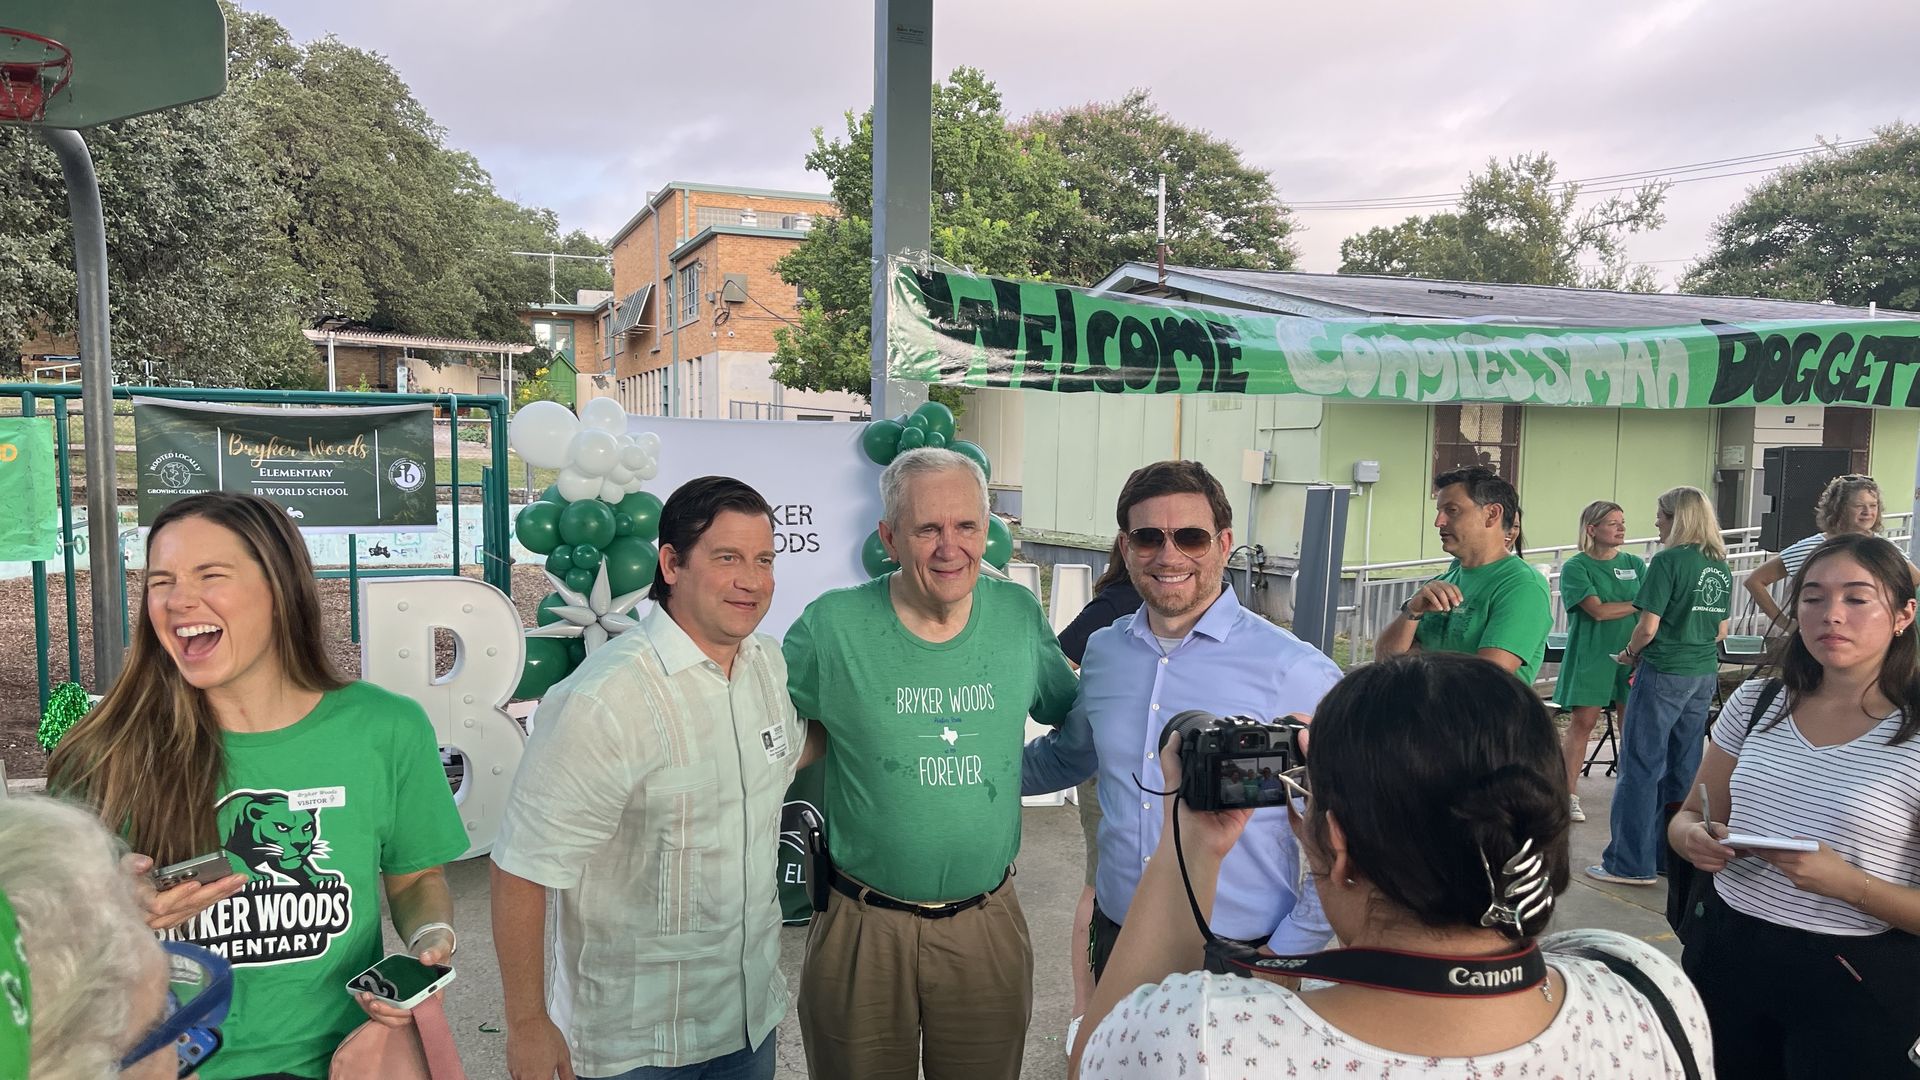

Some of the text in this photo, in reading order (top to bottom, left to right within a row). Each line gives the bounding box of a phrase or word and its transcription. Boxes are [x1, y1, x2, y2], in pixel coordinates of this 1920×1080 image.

[150, 452, 202, 471] ROOTED LOCALLY
[228, 432, 370, 468] Bryker Woods
[260, 468, 333, 477] ELEMENTARY
[253, 488, 349, 496] IB WORLD SCHOOL
[897, 683, 995, 714] BRYKER WOODS
[920, 755, 982, 786] FOREVER
[297, 798, 328, 806] VISITOR
[254, 892, 346, 932] WOODS
[202, 932, 322, 958] MENTARY
[1448, 965, 1523, 987] Canon
